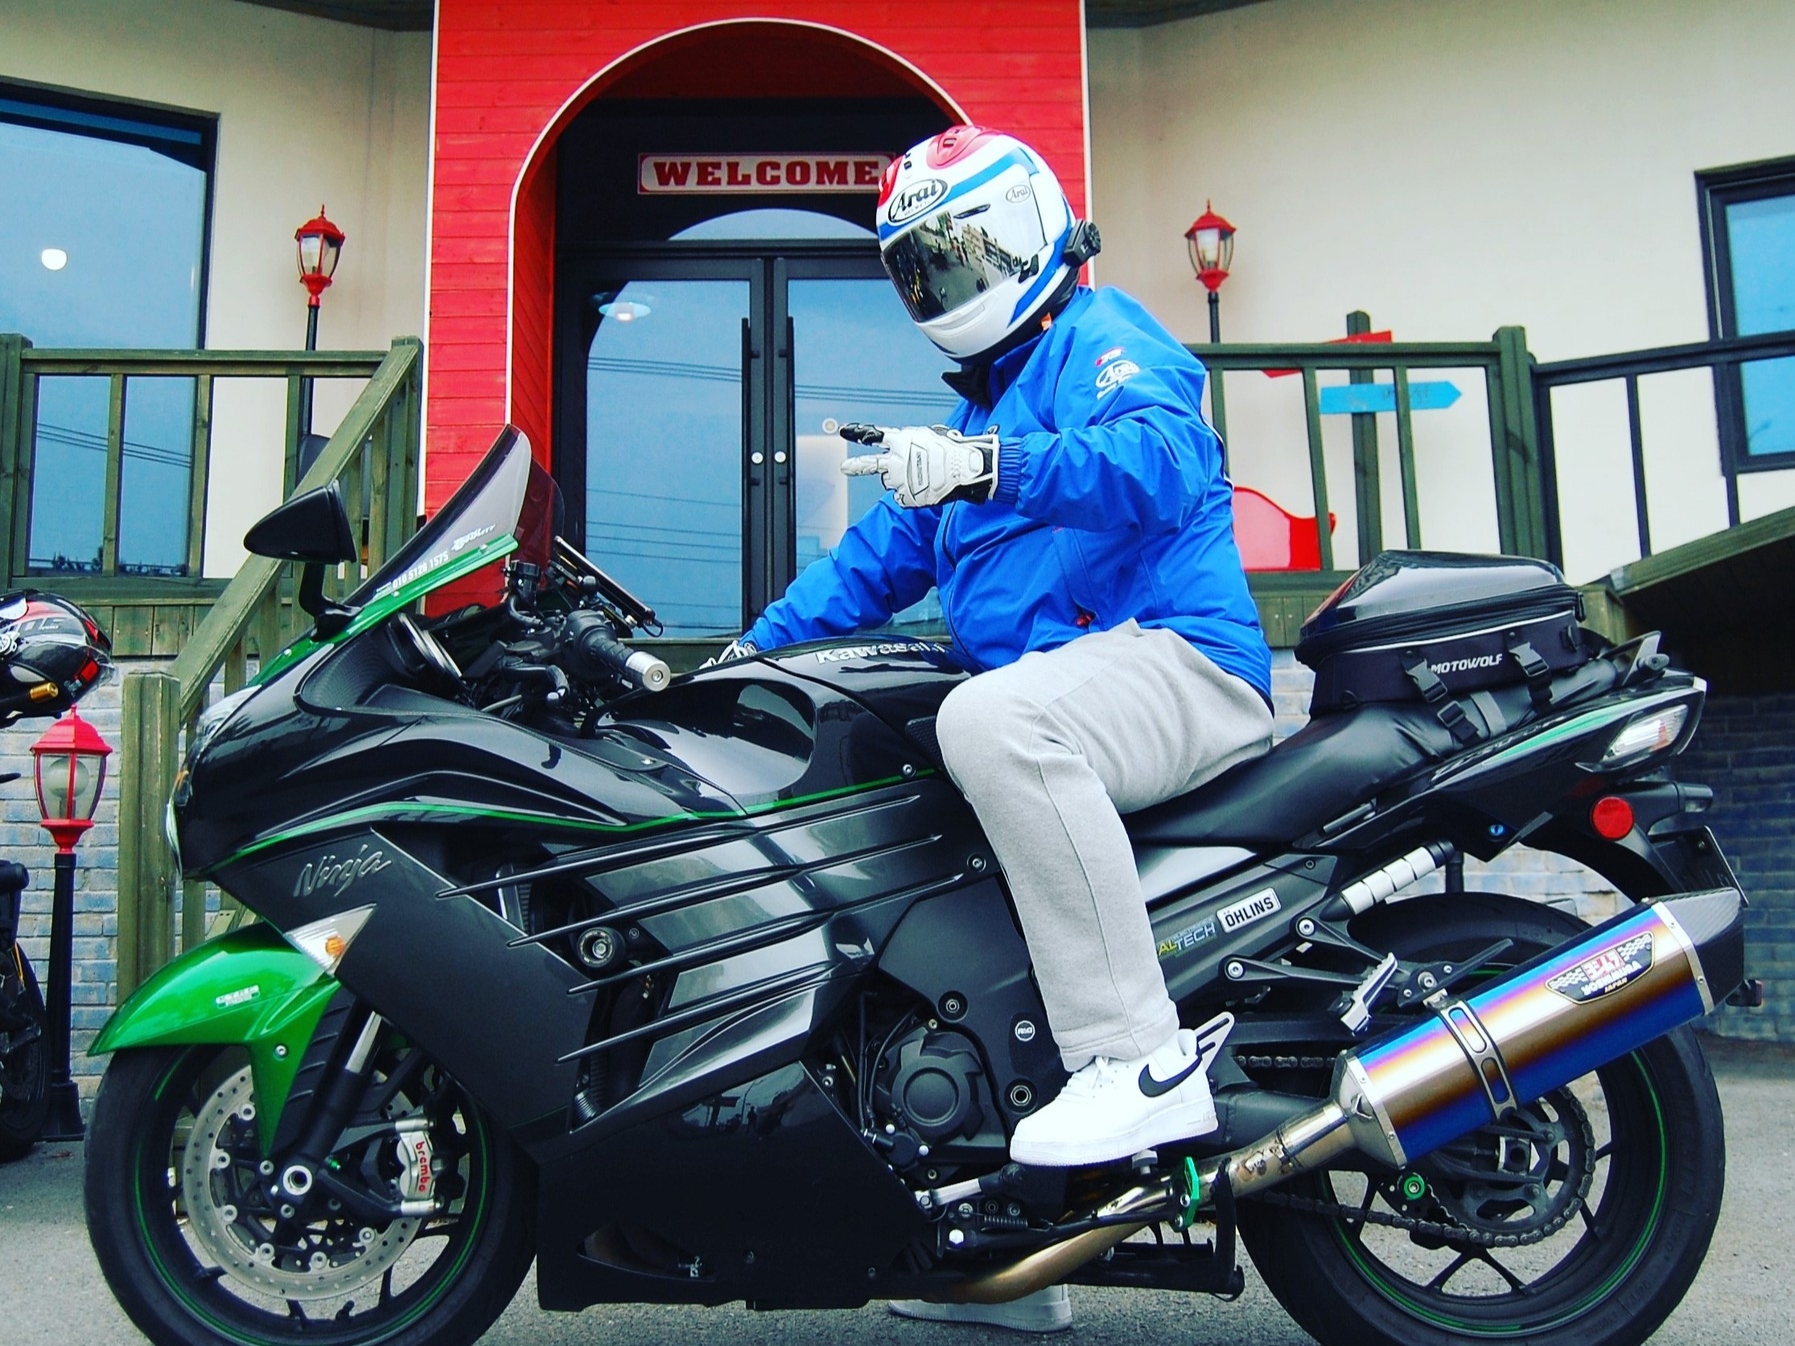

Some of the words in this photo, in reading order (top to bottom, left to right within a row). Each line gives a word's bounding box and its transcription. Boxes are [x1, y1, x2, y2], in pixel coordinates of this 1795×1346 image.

[652, 160, 880, 187] WELCOME
[891, 180, 939, 219] Arai
[1009, 186, 1028, 199] Arai
[1430, 653, 1503, 675] MOTOWOLF
[293, 844, 392, 898] Ninja
[415, 1140, 431, 1193] brembo
